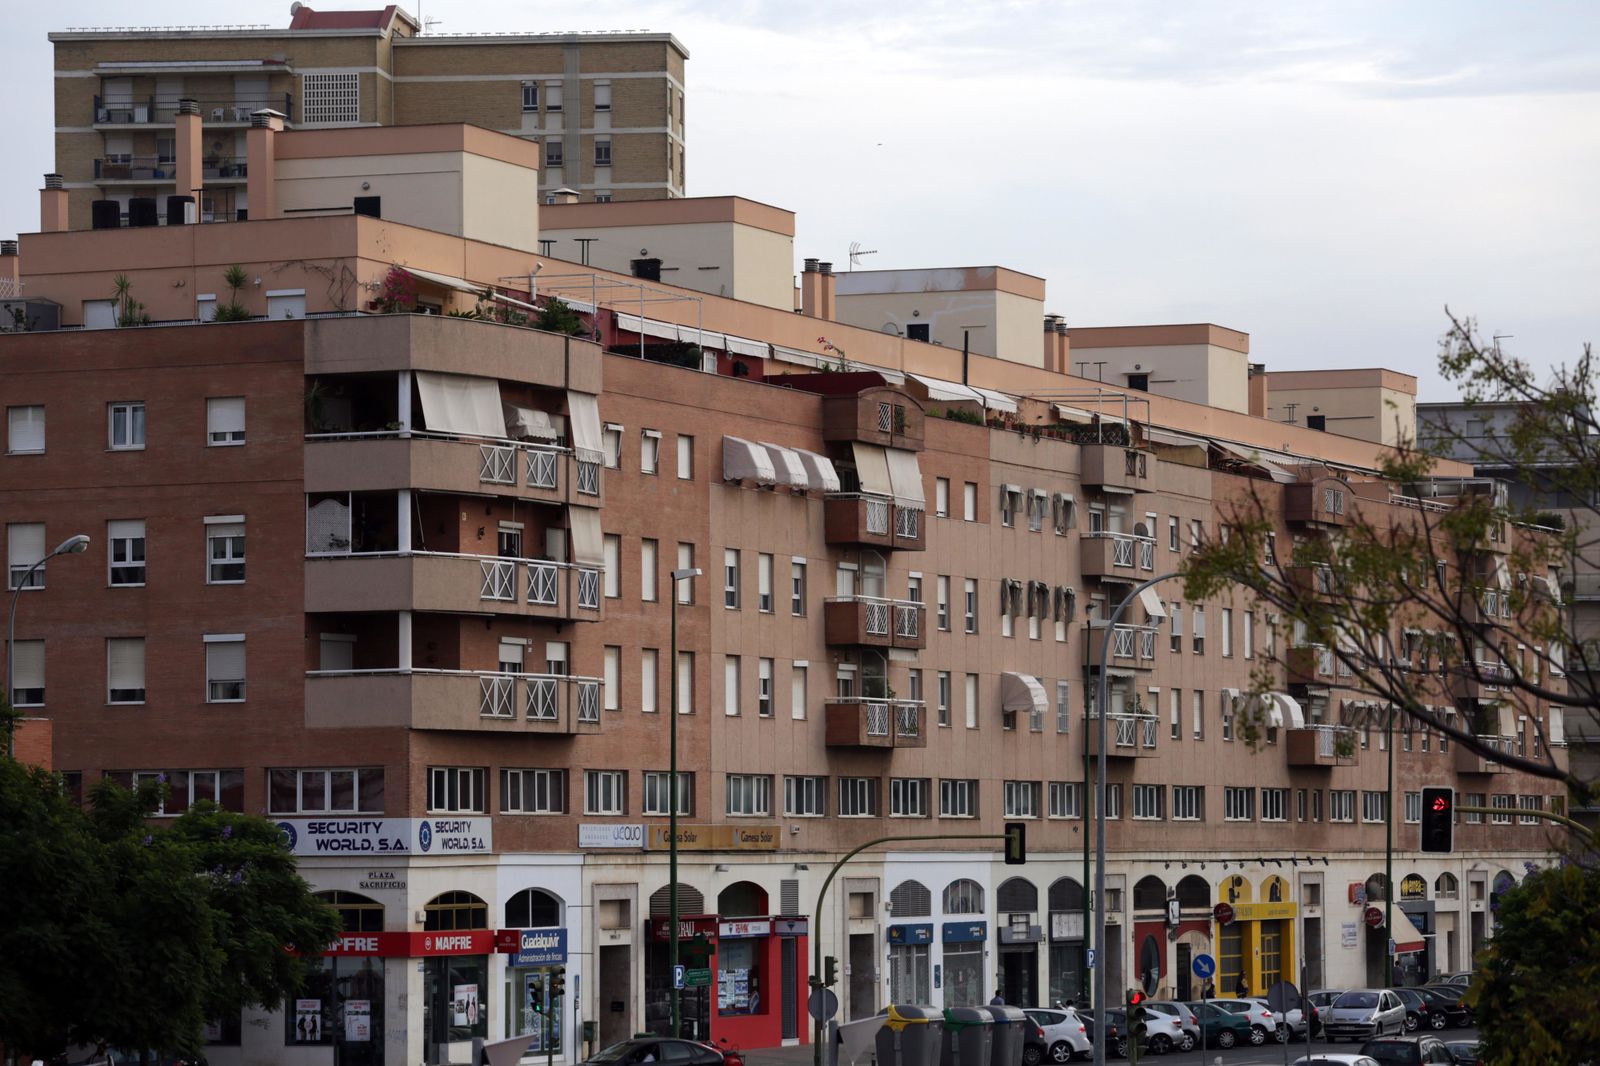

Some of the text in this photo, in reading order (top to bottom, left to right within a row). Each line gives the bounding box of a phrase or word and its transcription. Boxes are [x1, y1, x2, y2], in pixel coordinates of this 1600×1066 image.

[307, 821, 384, 834] SECURITY
[434, 820, 472, 833] SECURITY
[760, 831, 773, 842] Solar
[315, 838, 408, 852] WORLD, S.A.
[441, 837, 486, 850] WORLD, S.A.
[368, 871, 395, 879] PLAZA
[359, 881, 407, 889] SACRIFICIO
[435, 935, 472, 951] MAPFRE
[521, 932, 560, 951] Guadalquivir
[1088, 951, 1095, 966] P
[675, 967, 683, 986] P
